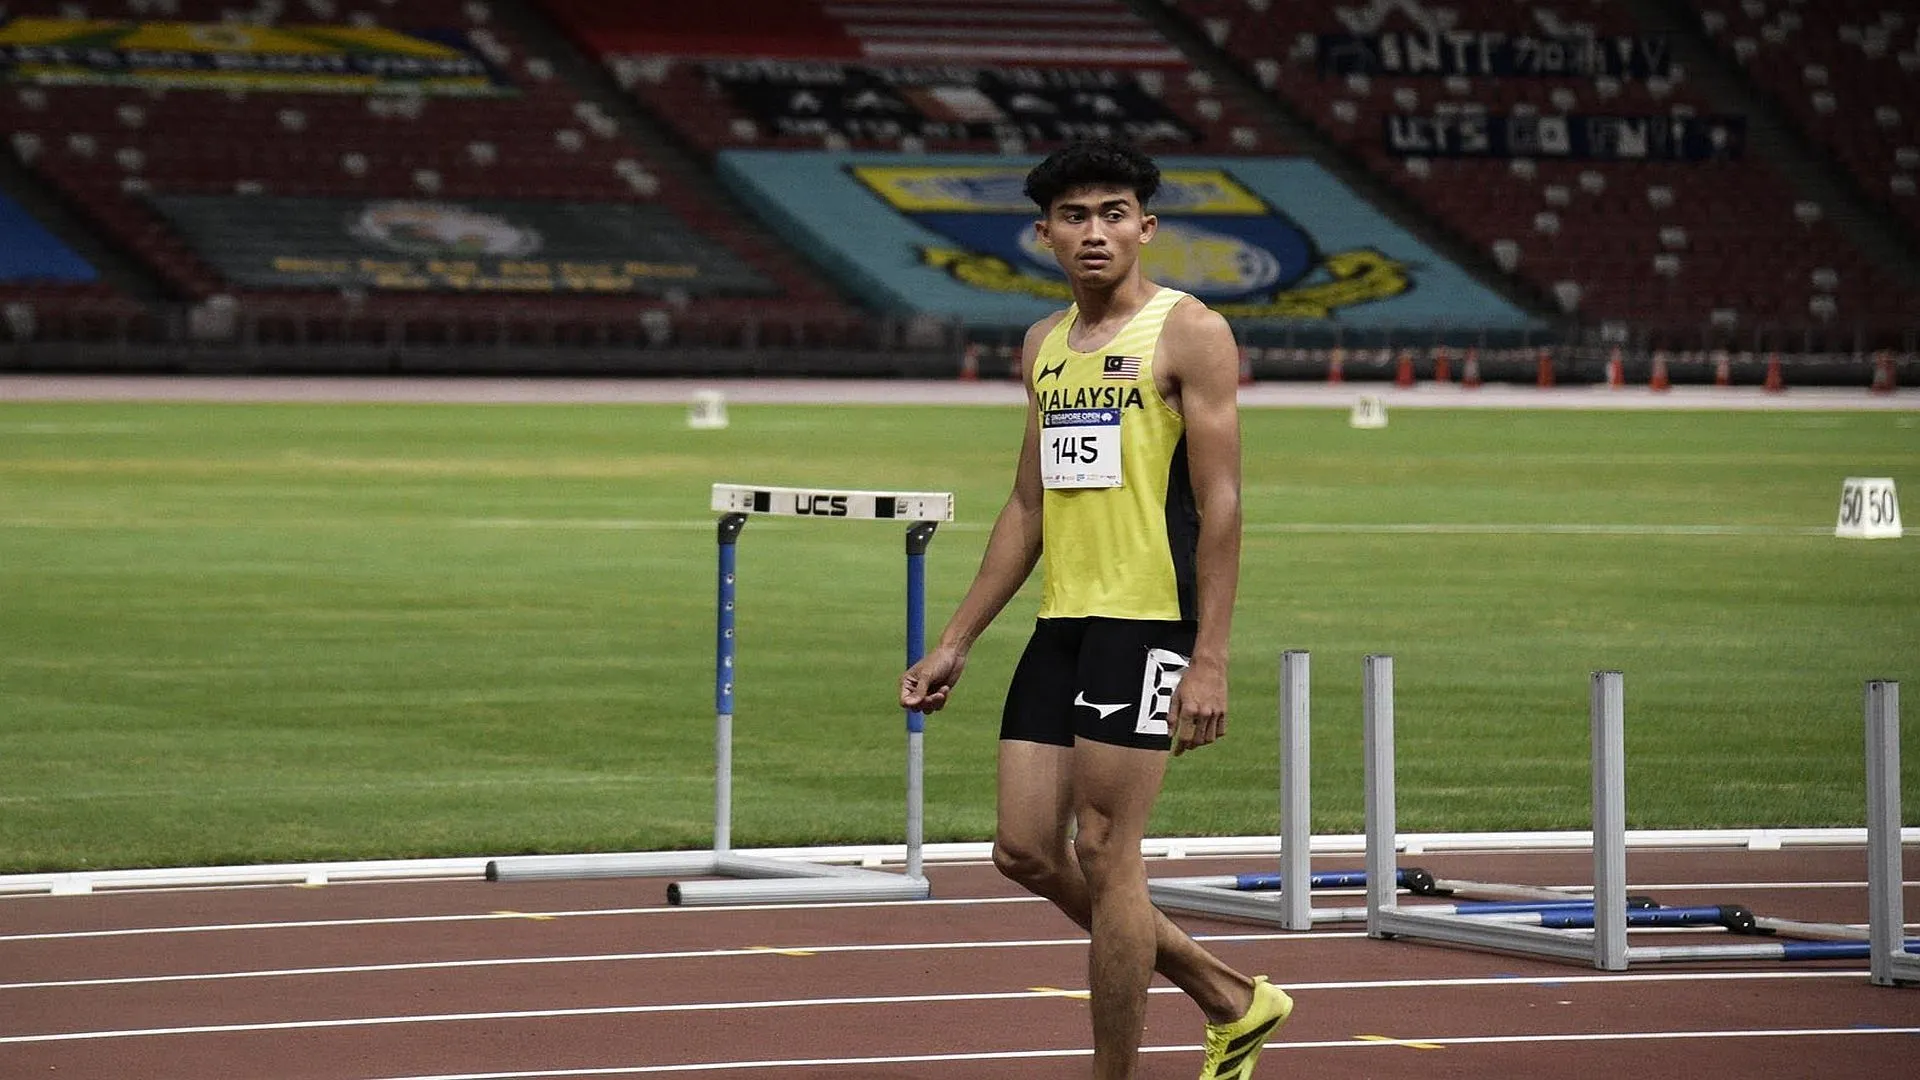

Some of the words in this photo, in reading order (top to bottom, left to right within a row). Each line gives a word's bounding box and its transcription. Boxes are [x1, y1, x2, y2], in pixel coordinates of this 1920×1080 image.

[1036, 387, 1144, 411] MALAYSIA
[1052, 436, 1098, 464] 145
[795, 495, 847, 516] UCS
[1841, 486, 1863, 526] 50
[1869, 488, 1894, 525] 50
